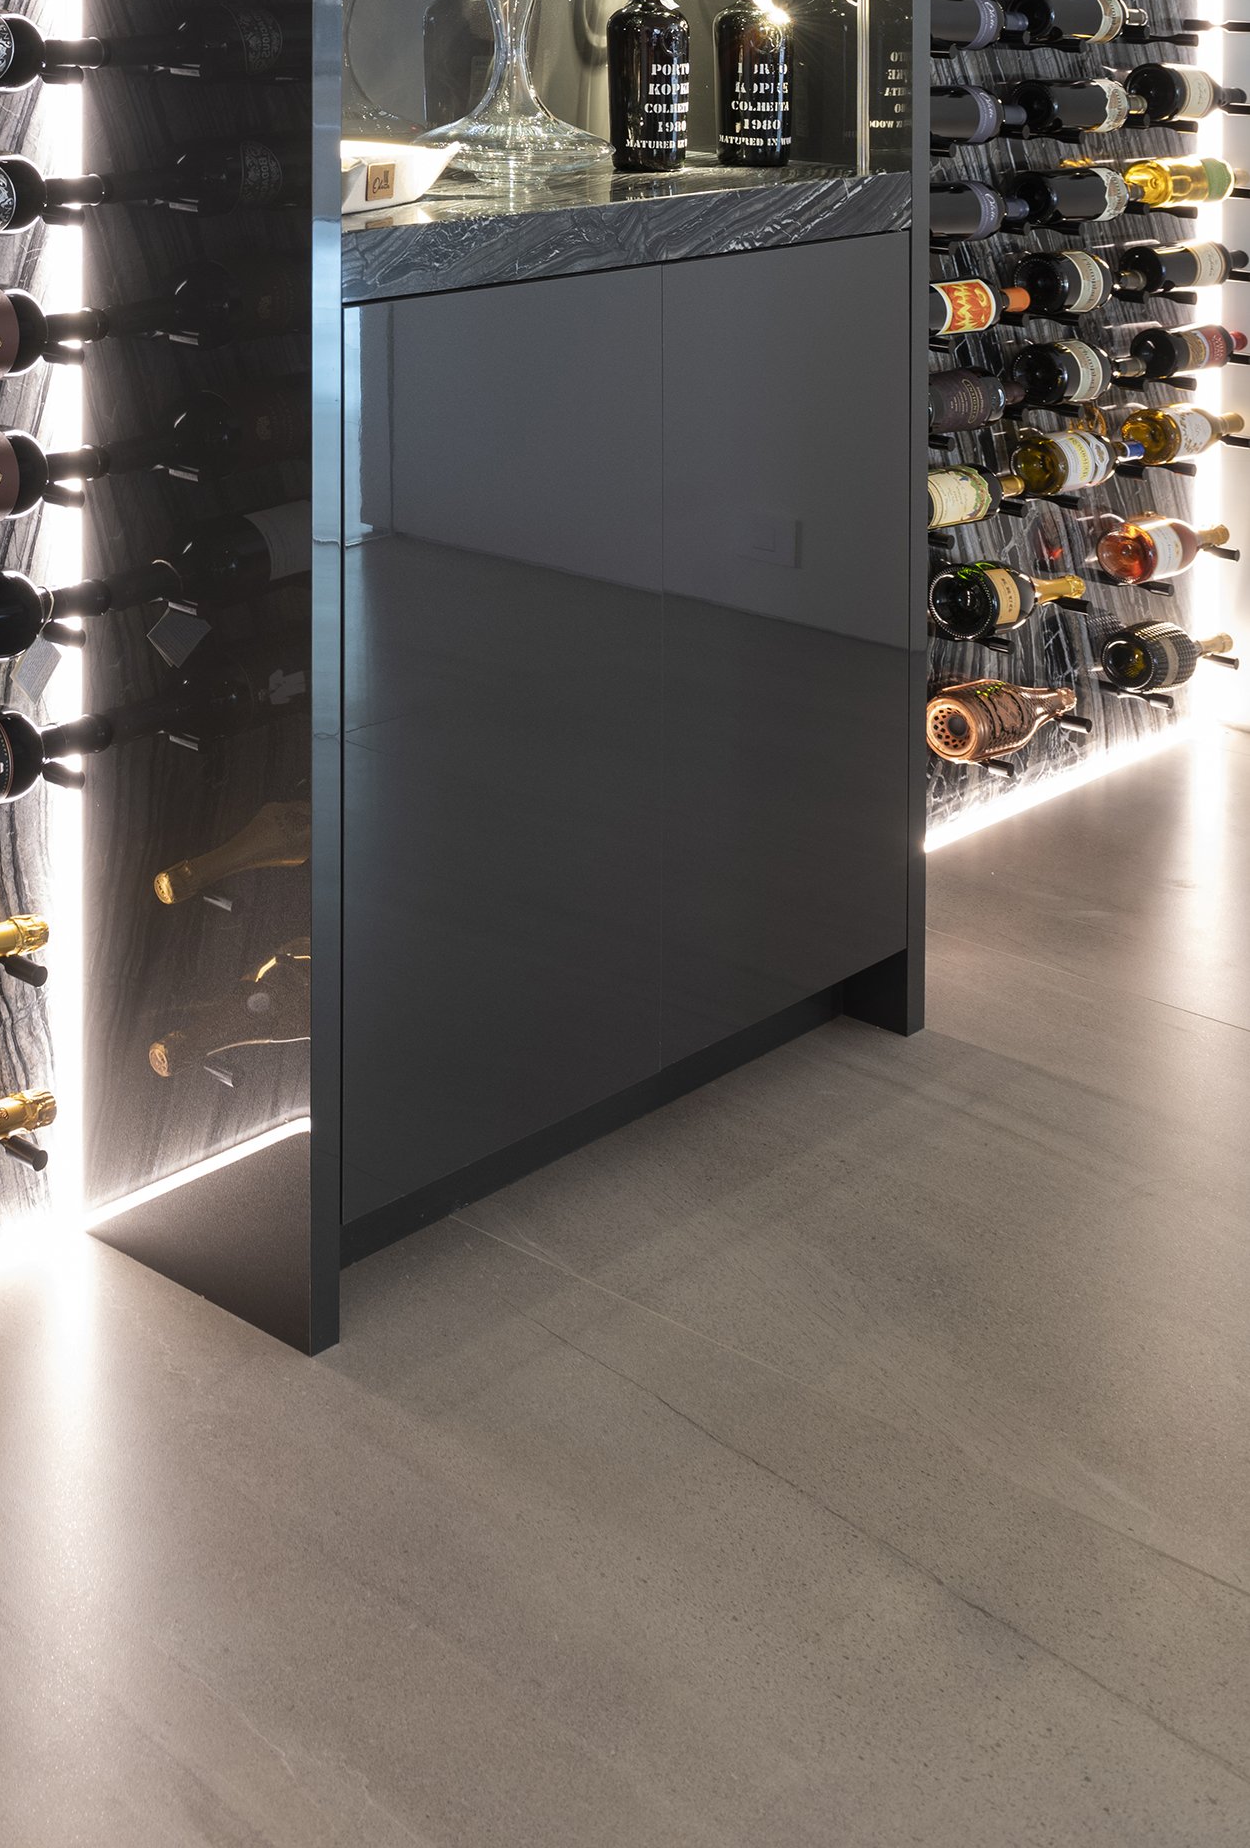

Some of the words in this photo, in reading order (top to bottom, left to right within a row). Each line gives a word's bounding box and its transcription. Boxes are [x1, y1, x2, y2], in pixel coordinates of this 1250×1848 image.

[658, 121, 687, 133] 1980
[743, 118, 781, 130] 1980
[625, 138, 676, 149] MATURED
[719, 135, 764, 146] MATURED
